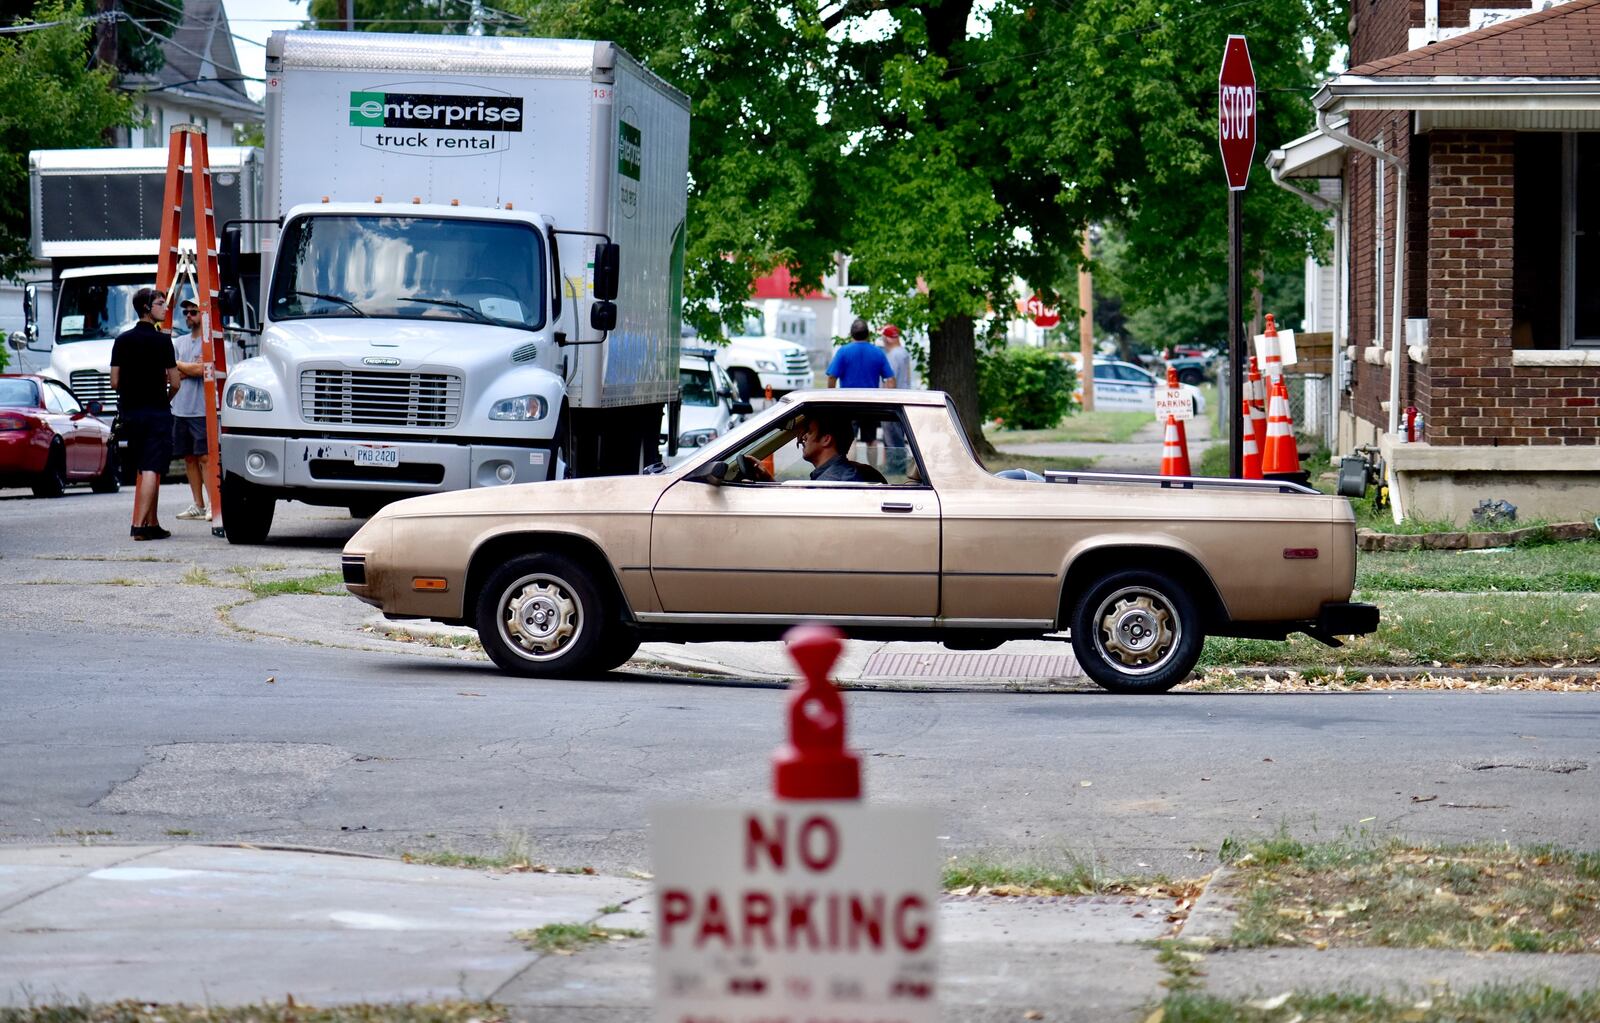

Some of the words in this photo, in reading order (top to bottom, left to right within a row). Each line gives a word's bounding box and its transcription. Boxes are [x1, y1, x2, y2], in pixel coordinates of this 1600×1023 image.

[360, 100, 520, 125] enterprise
[1222, 86, 1253, 140] STOP
[376, 132, 428, 147] truck
[436, 135, 495, 149] rental
[1157, 400, 1192, 408] PARKING
[375, 450, 396, 462] 2420
[745, 815, 841, 872] NO
[659, 890, 930, 951] PARKING
